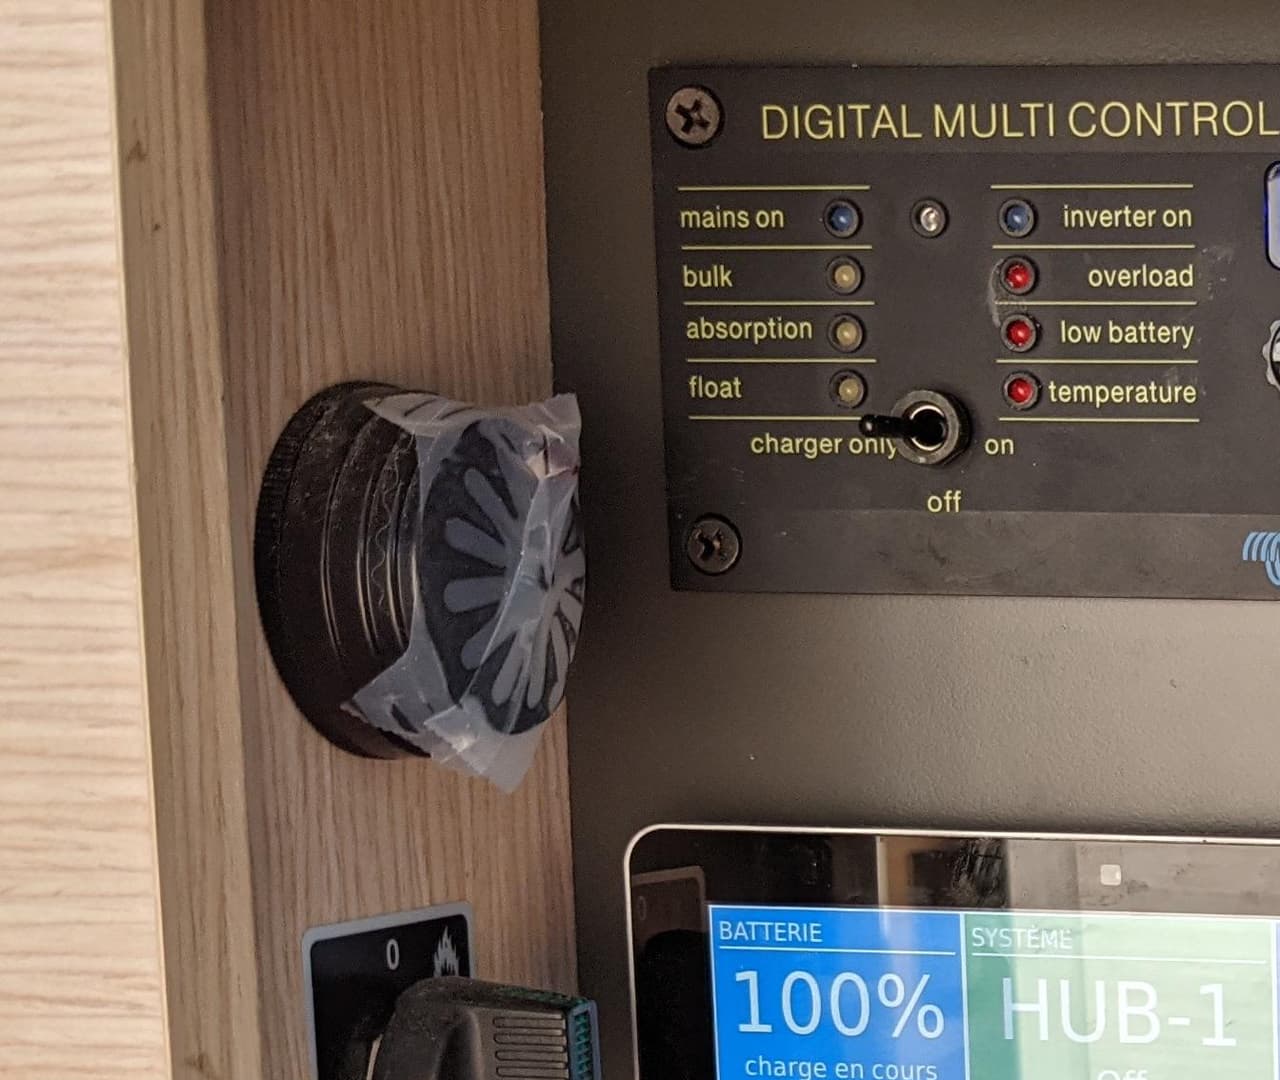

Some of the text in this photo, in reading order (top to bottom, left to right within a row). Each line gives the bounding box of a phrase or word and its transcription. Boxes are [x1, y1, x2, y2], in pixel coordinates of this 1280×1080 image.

[762, 100, 1280, 140] DIGITAL MULTI CONTROL
[680, 205, 784, 229] mains on
[1064, 204, 1192, 228] inverter on
[683, 264, 733, 288] bulk
[1088, 263, 1194, 287] overload
[686, 316, 813, 345] absorption
[1061, 320, 1194, 349] low battery
[688, 375, 742, 399] float
[1048, 380, 1197, 409] temperature
[750, 432, 897, 459] charger only
[984, 438, 1014, 455] on
[927, 489, 962, 513] off
[719, 921, 823, 943] BATTERIE
[971, 925, 1073, 952] SYSTÈME
[735, 970, 945, 1040] 100%
[1002, 976, 1238, 1049] HUB-1
[835, 1061, 864, 1079] en
[872, 1061, 938, 1080] cours
